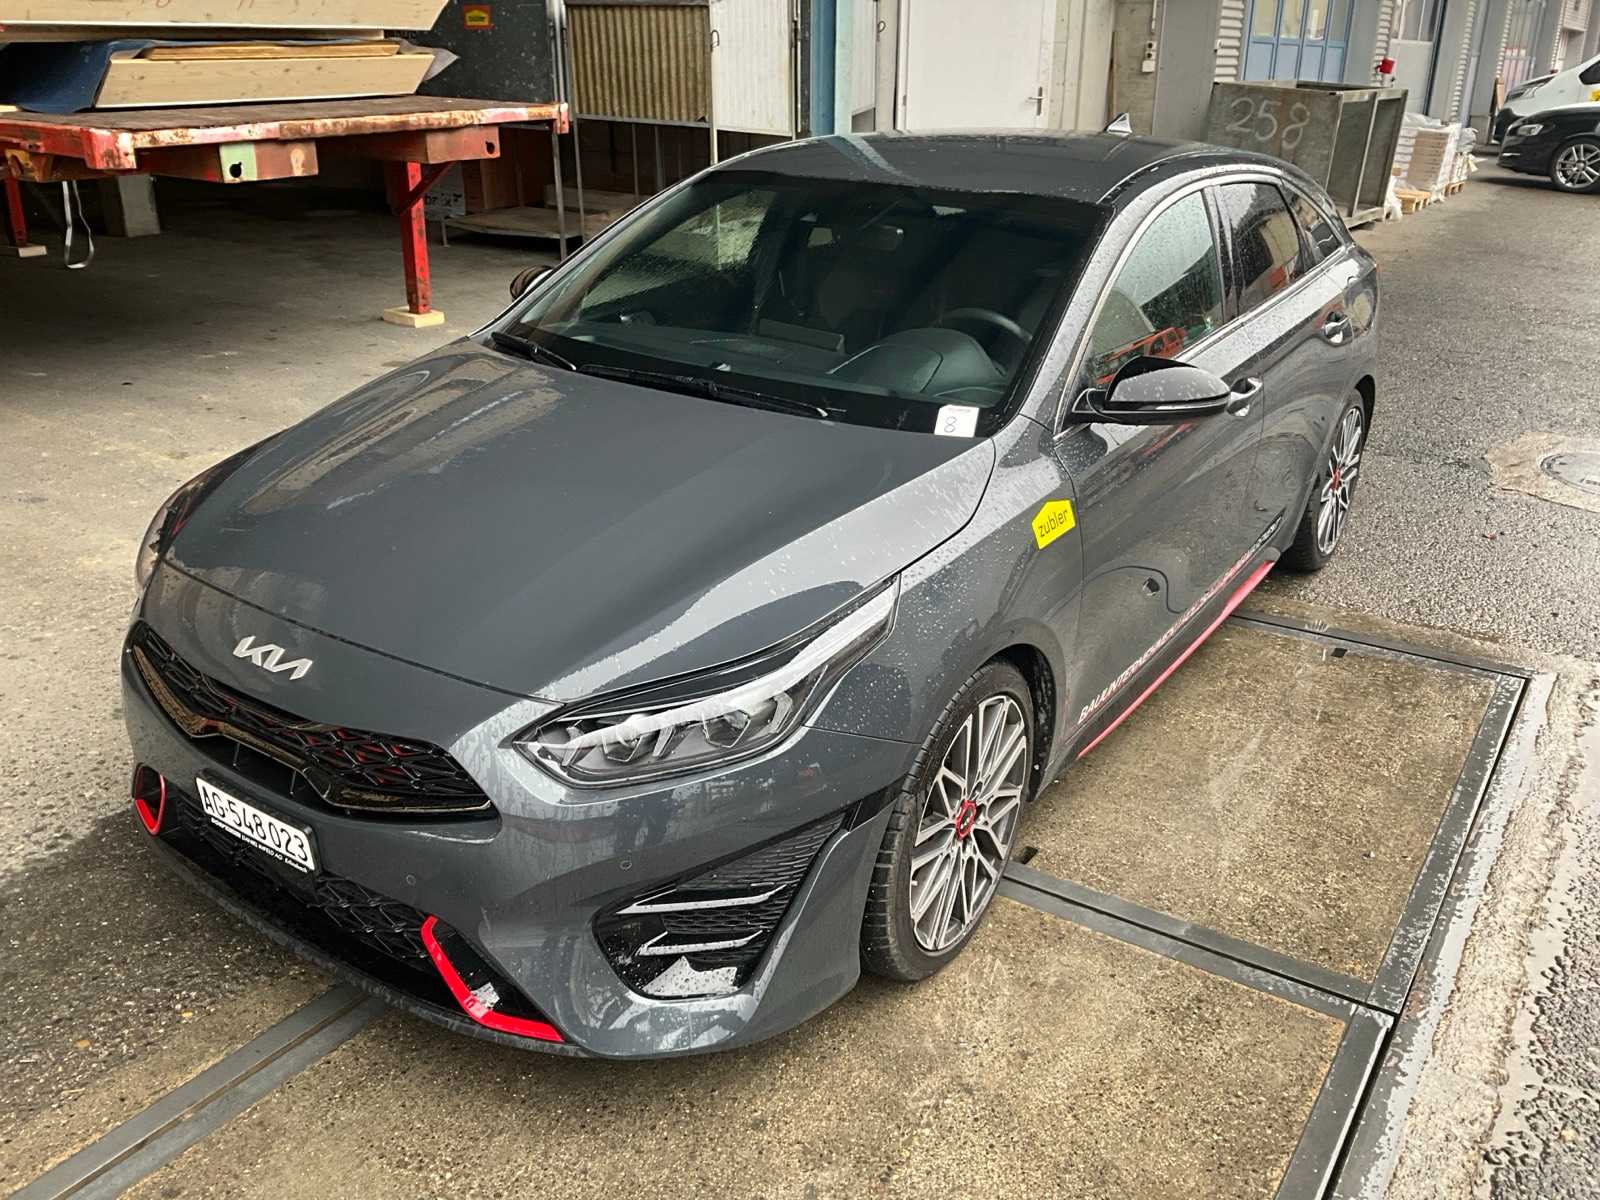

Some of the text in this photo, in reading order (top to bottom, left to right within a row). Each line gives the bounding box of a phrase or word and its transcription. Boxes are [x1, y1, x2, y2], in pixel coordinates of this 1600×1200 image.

[1225, 97, 1310, 149] 258
[944, 416, 957, 433] 8
[1038, 509, 1068, 538] zubler
[233, 635, 313, 680] KIA
